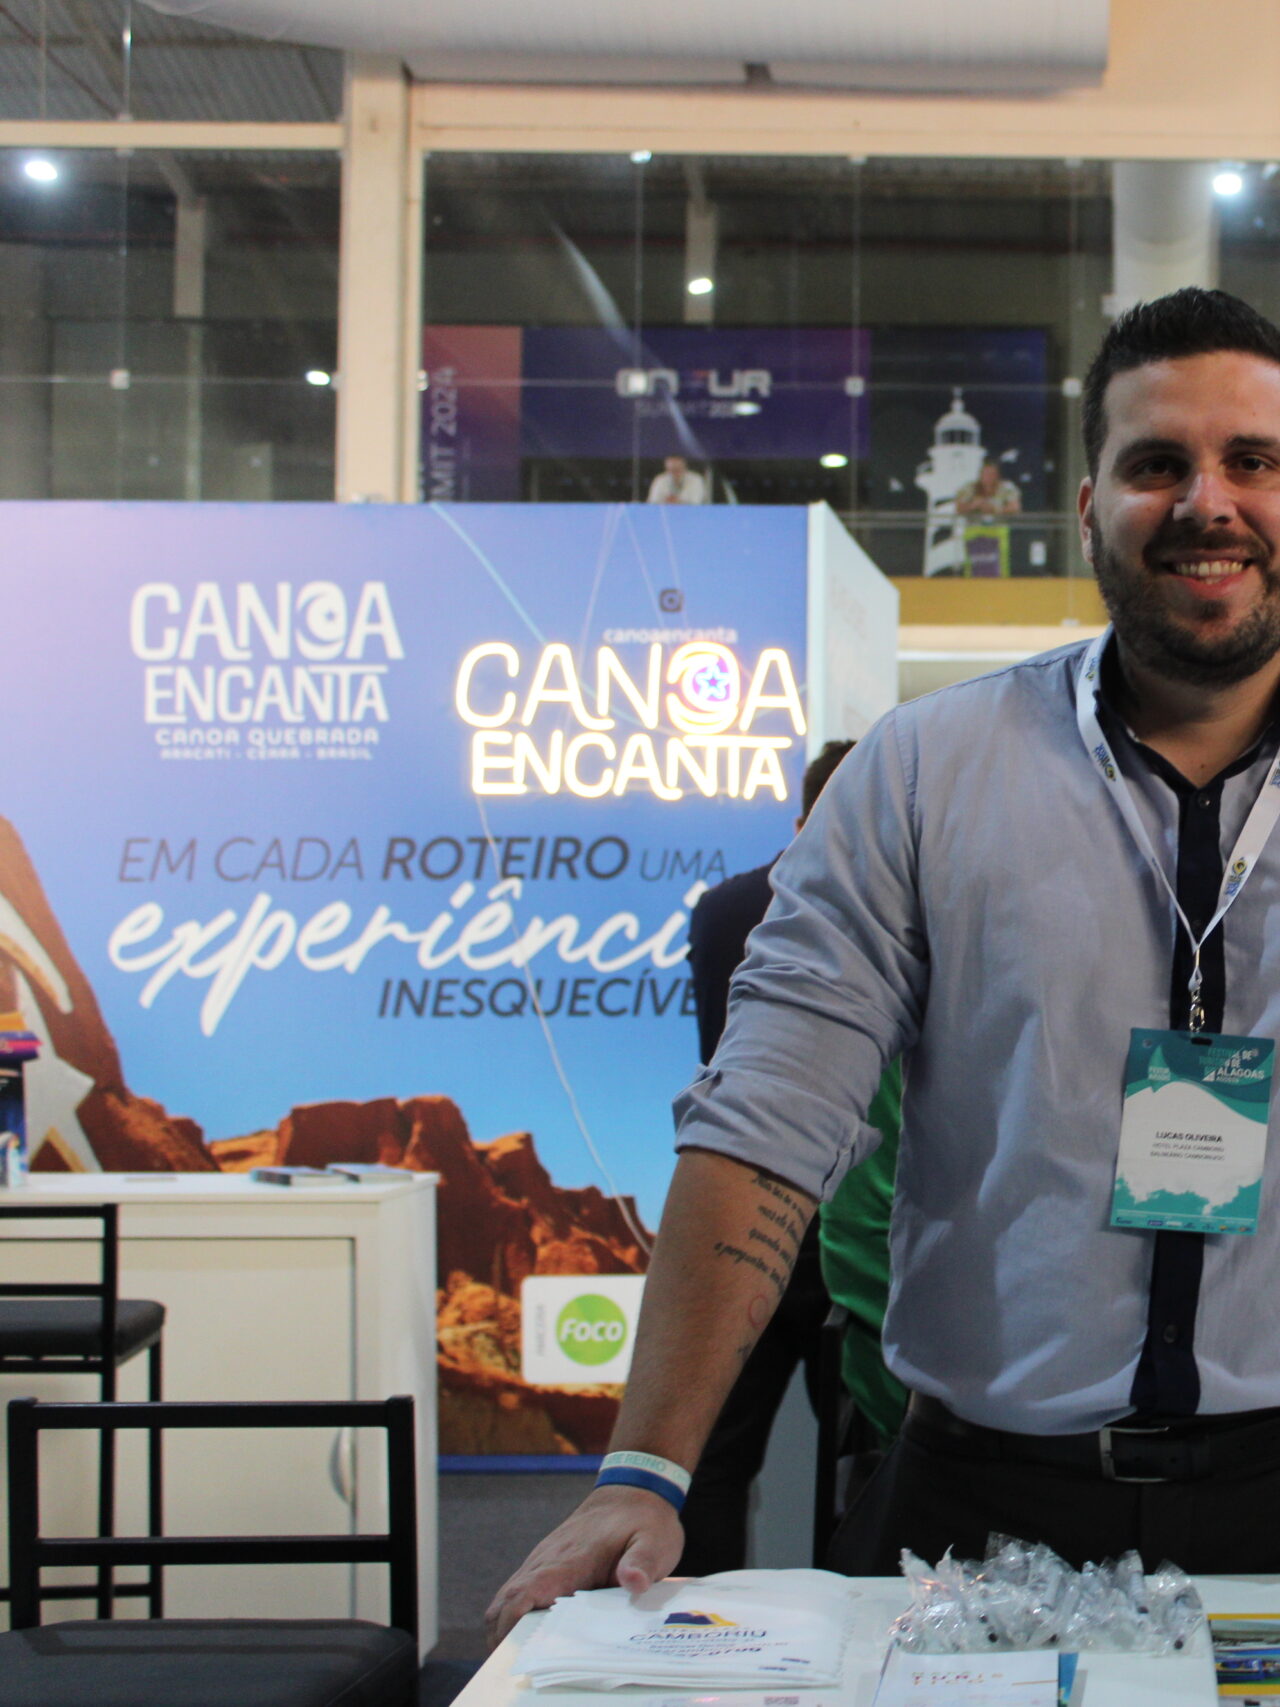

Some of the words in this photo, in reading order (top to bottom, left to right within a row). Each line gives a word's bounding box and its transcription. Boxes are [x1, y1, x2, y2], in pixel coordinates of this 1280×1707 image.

[429, 366, 458, 437] 2024
[429, 442, 456, 503] MIT
[130, 580, 405, 662] CANOA
[145, 663, 389, 724] ENCANTA
[455, 641, 807, 736] CANOA
[247, 727, 380, 749] QUEBRADA
[471, 729, 793, 802] ENCANTA
[118, 837, 198, 882] EM
[214, 836, 364, 882] CADA
[381, 835, 631, 881] ROTEIRO
[638, 848, 728, 882] UMA
[108, 876, 709, 1038] experiênci
[377, 968, 699, 1018] INESQUECÍVE
[1217, 1066, 1265, 1081] ALAGOAS
[1155, 1130, 1184, 1141] LUCAS
[1185, 1132, 1223, 1142] OLIVEIRA
